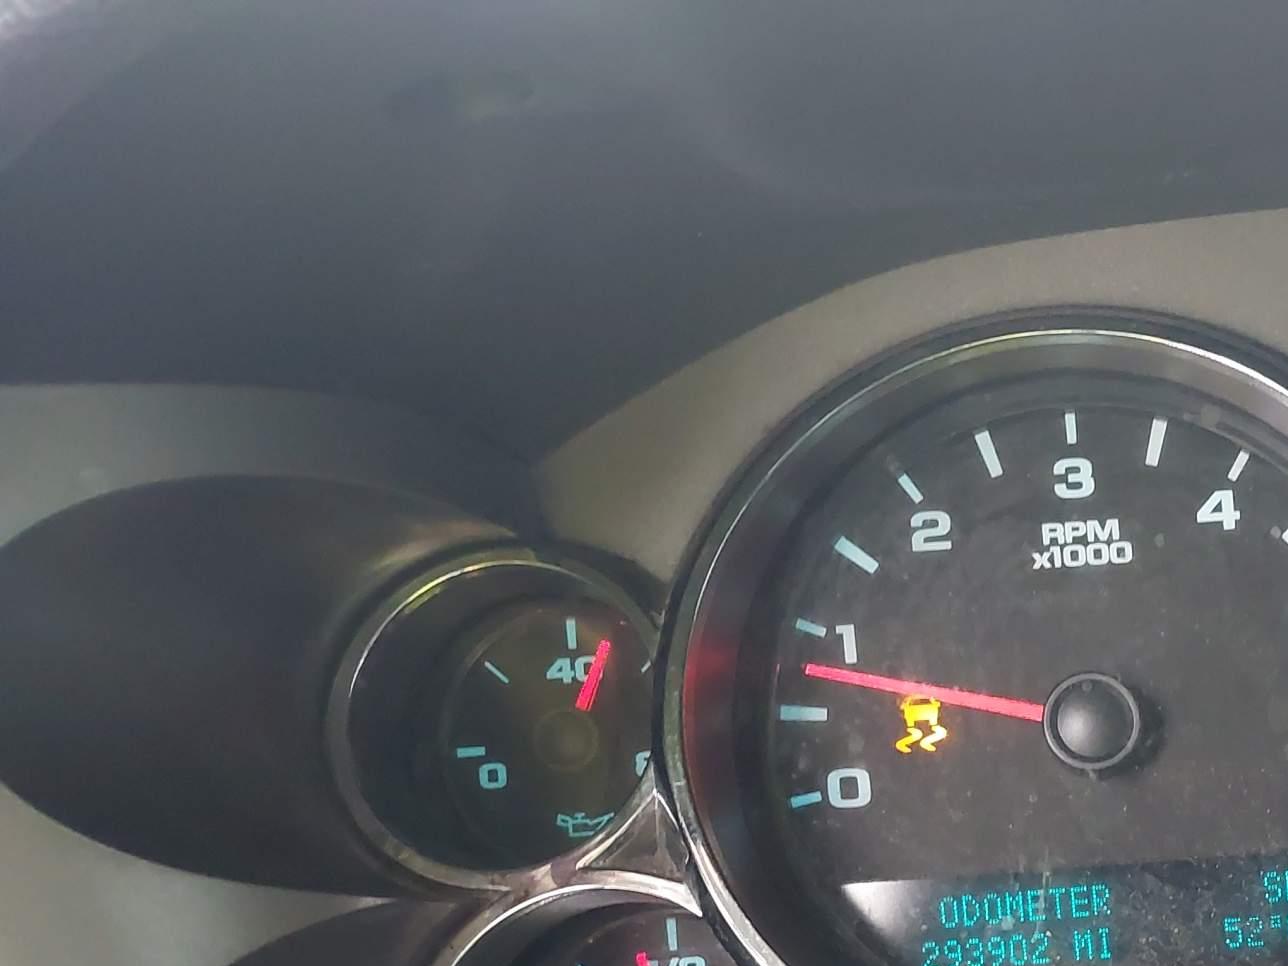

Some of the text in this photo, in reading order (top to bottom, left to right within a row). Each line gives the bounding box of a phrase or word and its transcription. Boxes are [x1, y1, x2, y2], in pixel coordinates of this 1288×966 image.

[1050, 456, 1097, 500] 3
[1194, 488, 1242, 532] 4
[908, 510, 954, 554] 2
[1040, 518, 1122, 548] RPM
[1031, 541, 1134, 571] x1000
[834, 622, 858, 665] 1
[546, 655, 603, 684] 40
[478, 760, 508, 792] 0
[826, 766, 872, 810] 0
[937, 882, 1113, 930] ODOMETER
[1072, 926, 1113, 962] MI
